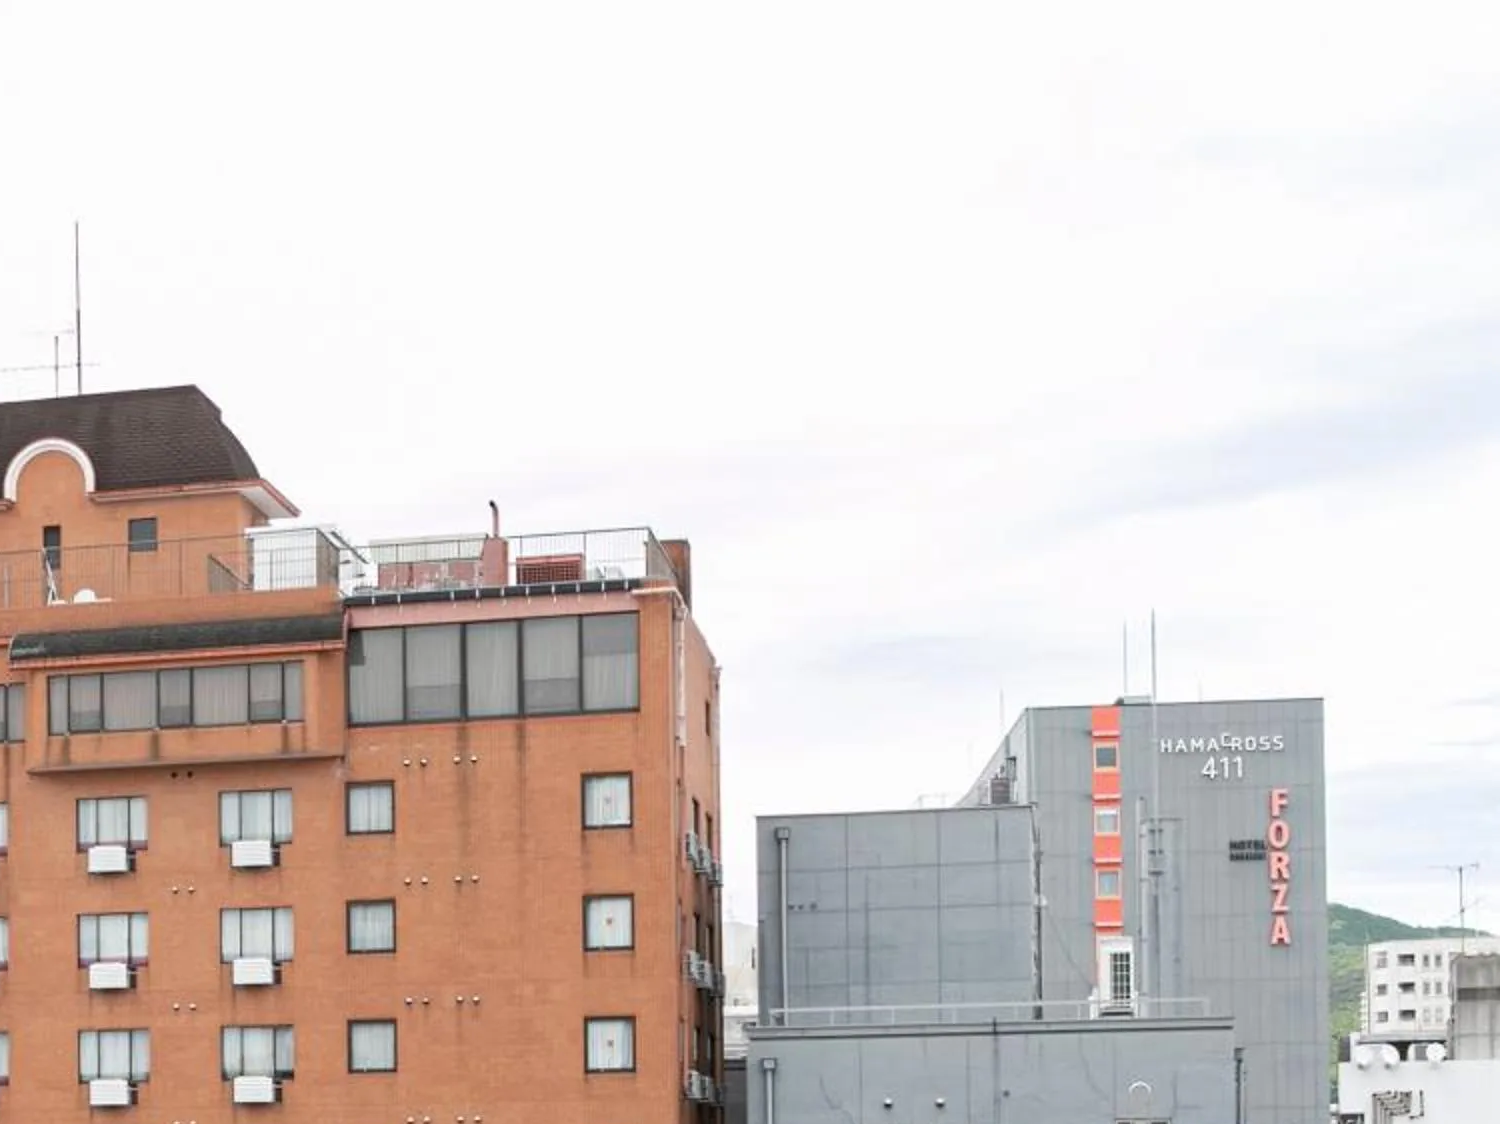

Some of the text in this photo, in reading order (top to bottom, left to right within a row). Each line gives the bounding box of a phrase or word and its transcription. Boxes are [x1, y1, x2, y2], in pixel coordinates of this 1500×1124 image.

[1160, 732, 1285, 753] HAMACROSS
[1201, 756, 1244, 779] 411
[1268, 788, 1292, 946] FORZA
